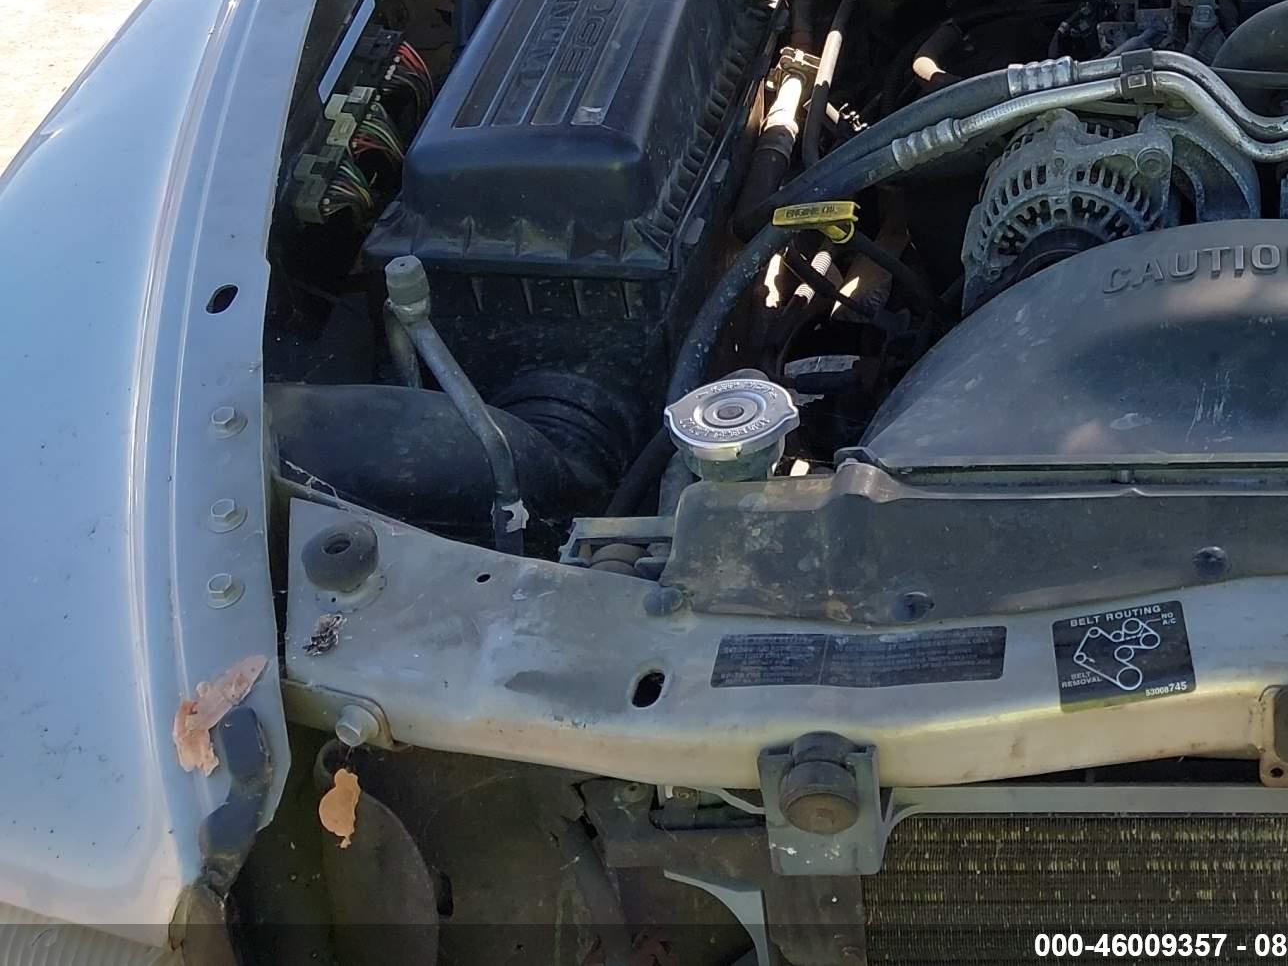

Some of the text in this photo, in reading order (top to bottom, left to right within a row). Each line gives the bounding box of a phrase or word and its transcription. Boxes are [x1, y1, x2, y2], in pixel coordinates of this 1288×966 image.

[1070, 605, 1162, 627] BELT ROUTING
[1070, 672, 1092, 680] BELT
[1061, 677, 1103, 689] REMOVAL
